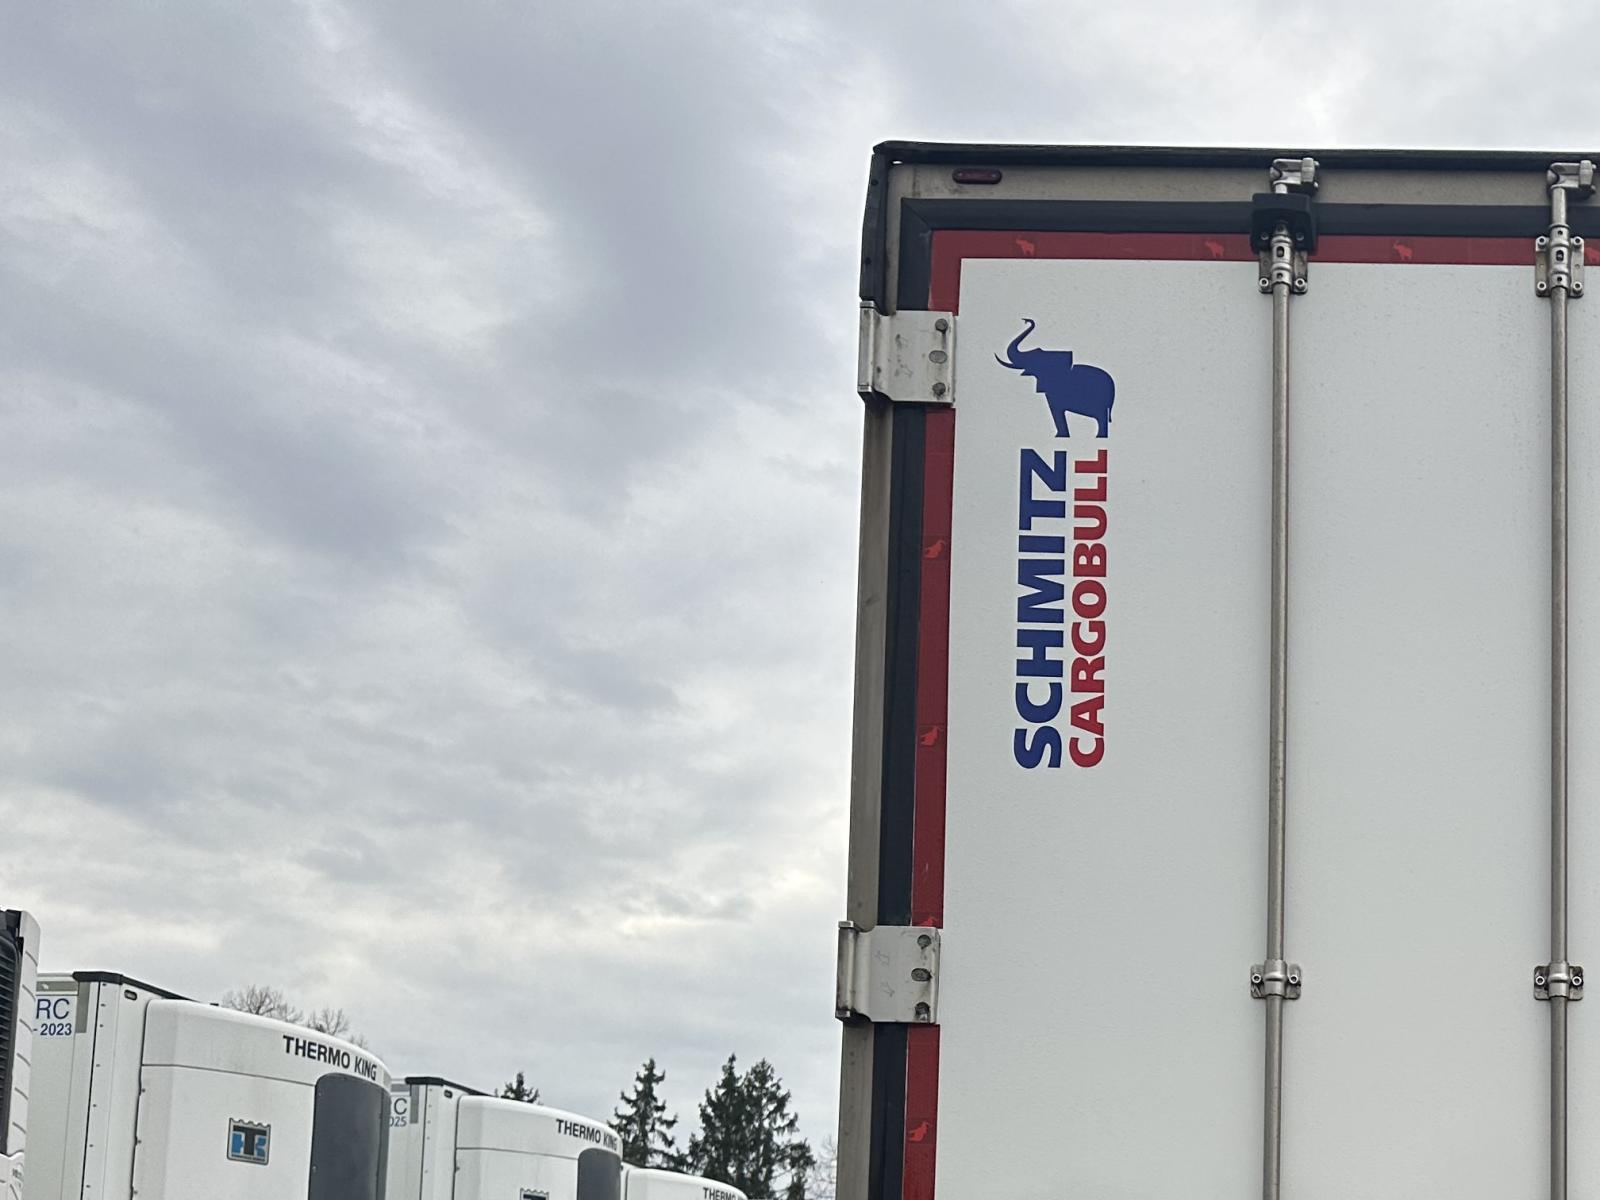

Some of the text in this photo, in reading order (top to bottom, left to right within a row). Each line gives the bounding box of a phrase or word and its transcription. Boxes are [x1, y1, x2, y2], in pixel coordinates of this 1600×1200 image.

[1014, 448, 1067, 769] SCHMITZ
[1069, 449, 1108, 768] CARGOBULL
[283, 1034, 378, 1081] THERMO KING
[556, 1118, 601, 1143] THERMO
